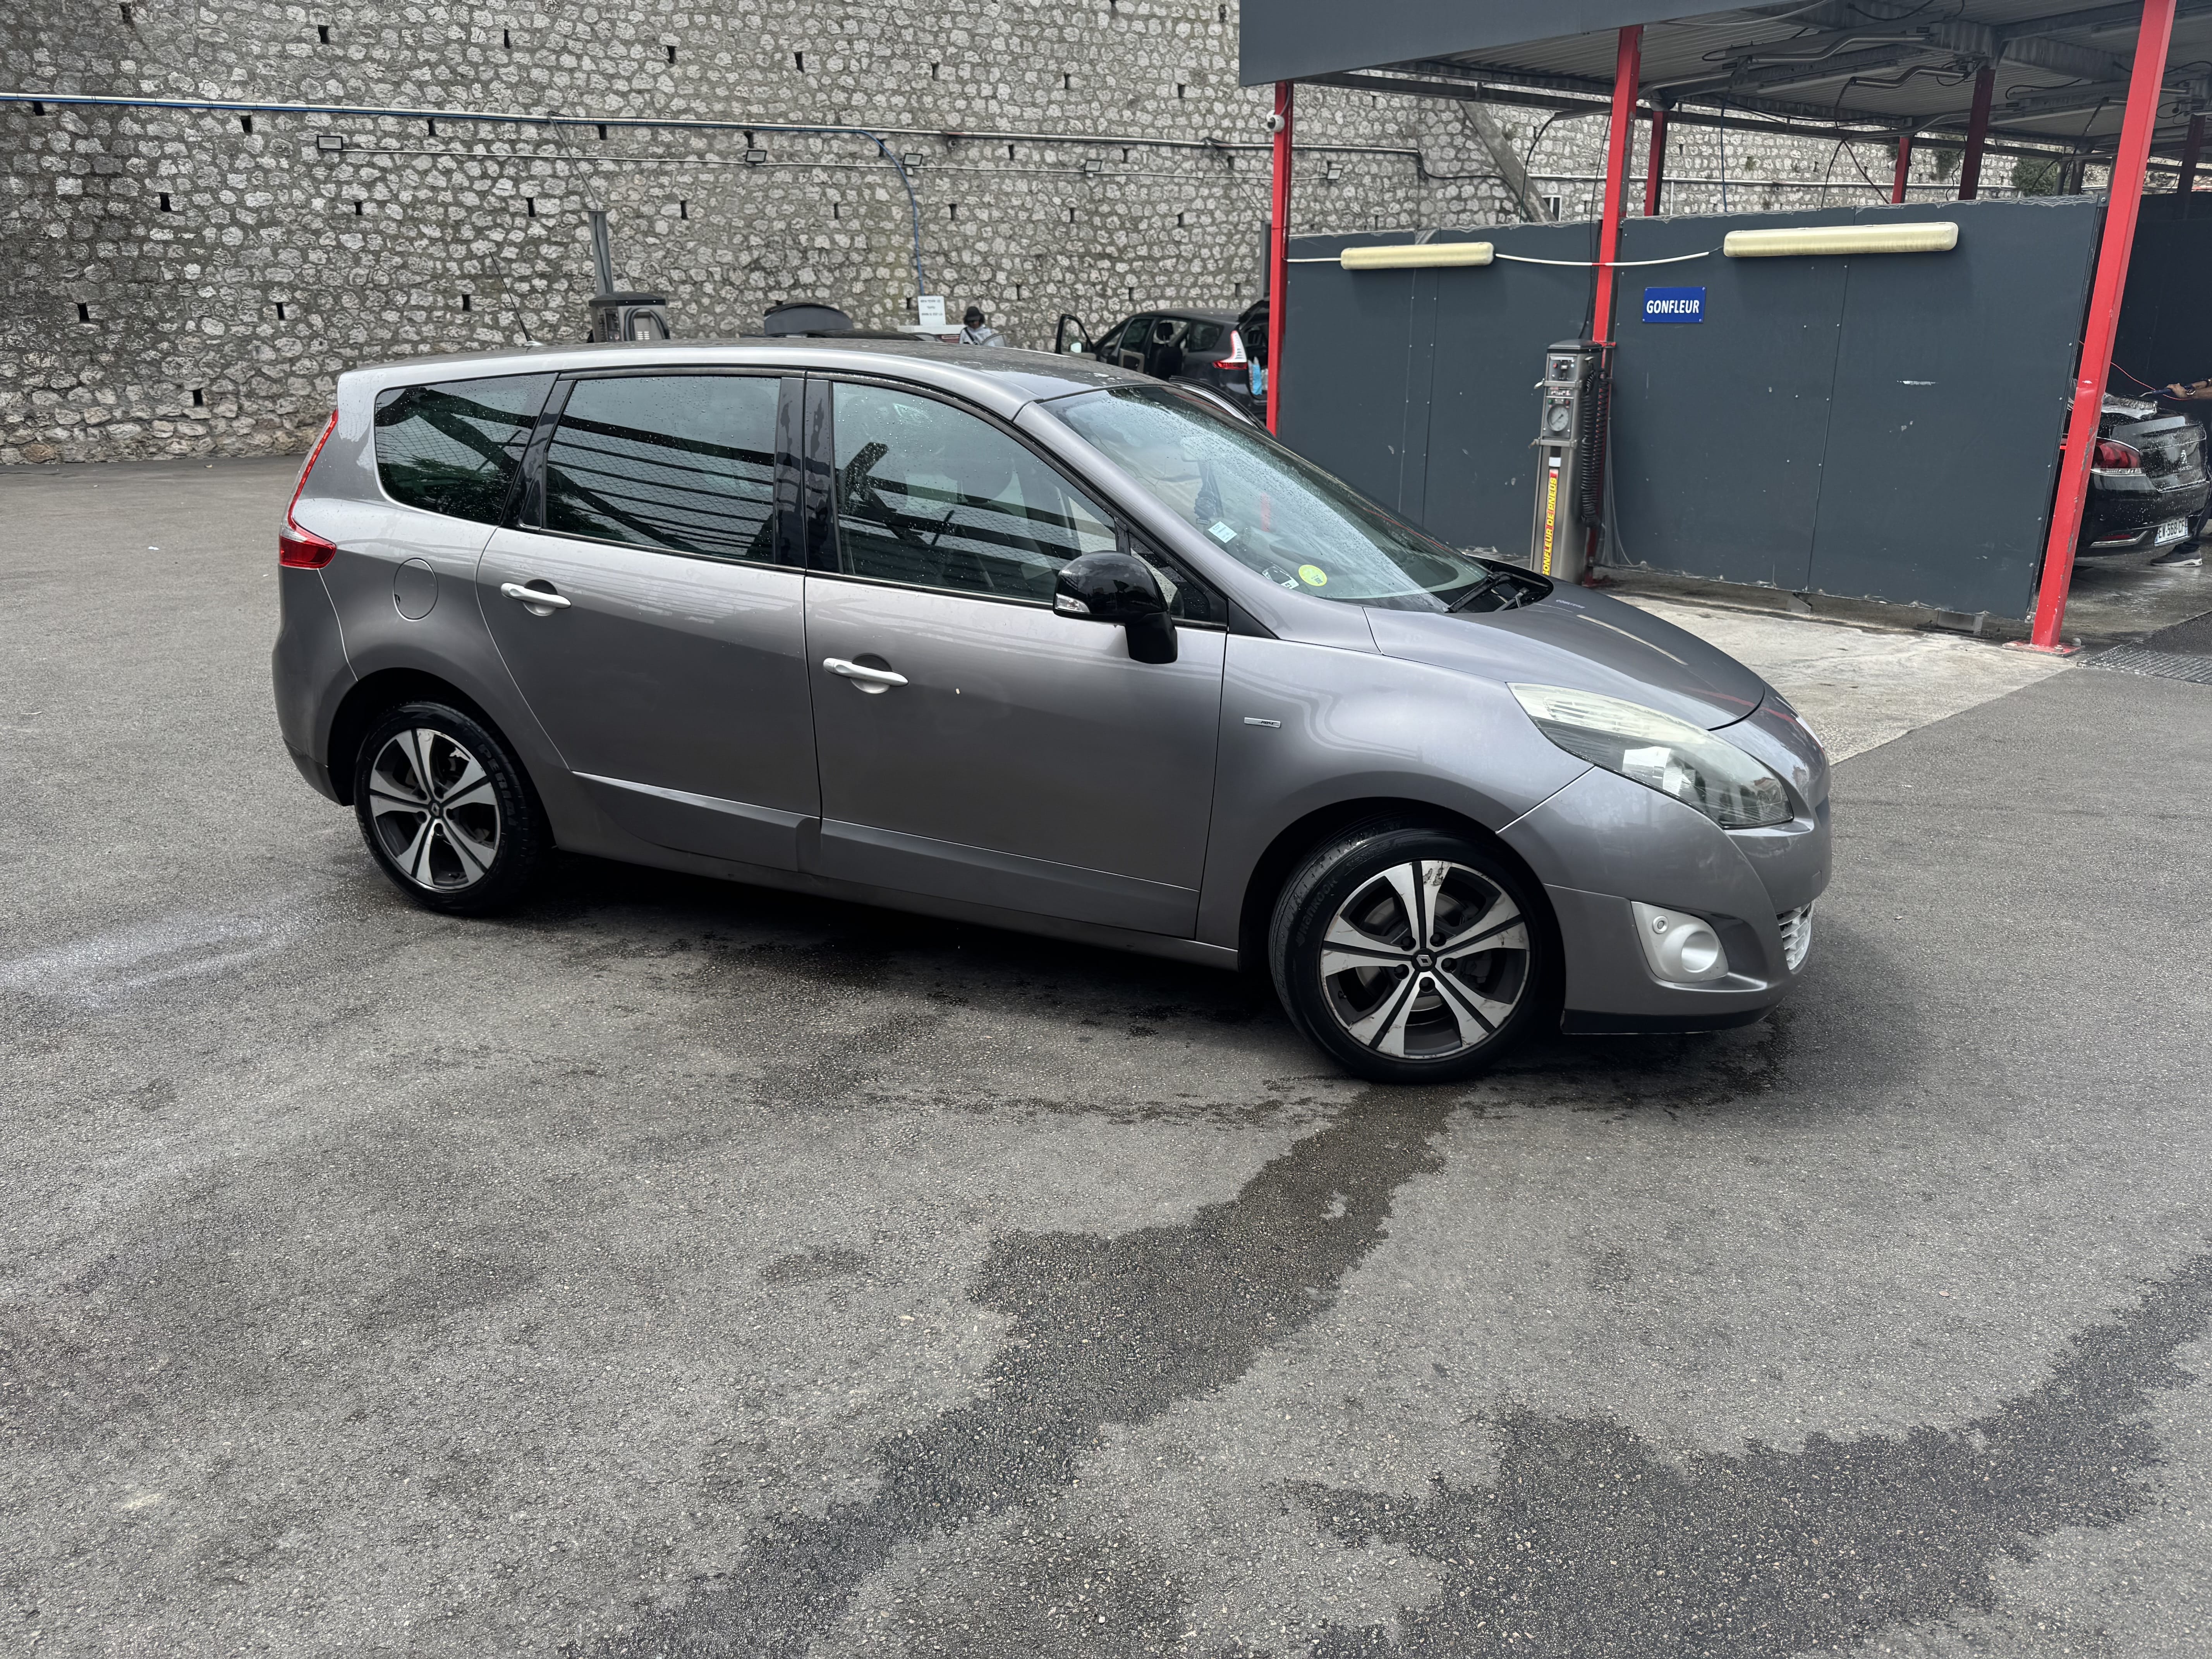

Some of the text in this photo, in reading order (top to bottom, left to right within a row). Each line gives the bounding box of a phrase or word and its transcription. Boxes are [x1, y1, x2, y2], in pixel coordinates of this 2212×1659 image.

[1647, 300, 1699, 313] GONFLEUR
[1548, 477, 1557, 511] PNEUS
[1546, 512, 1554, 527] DE
